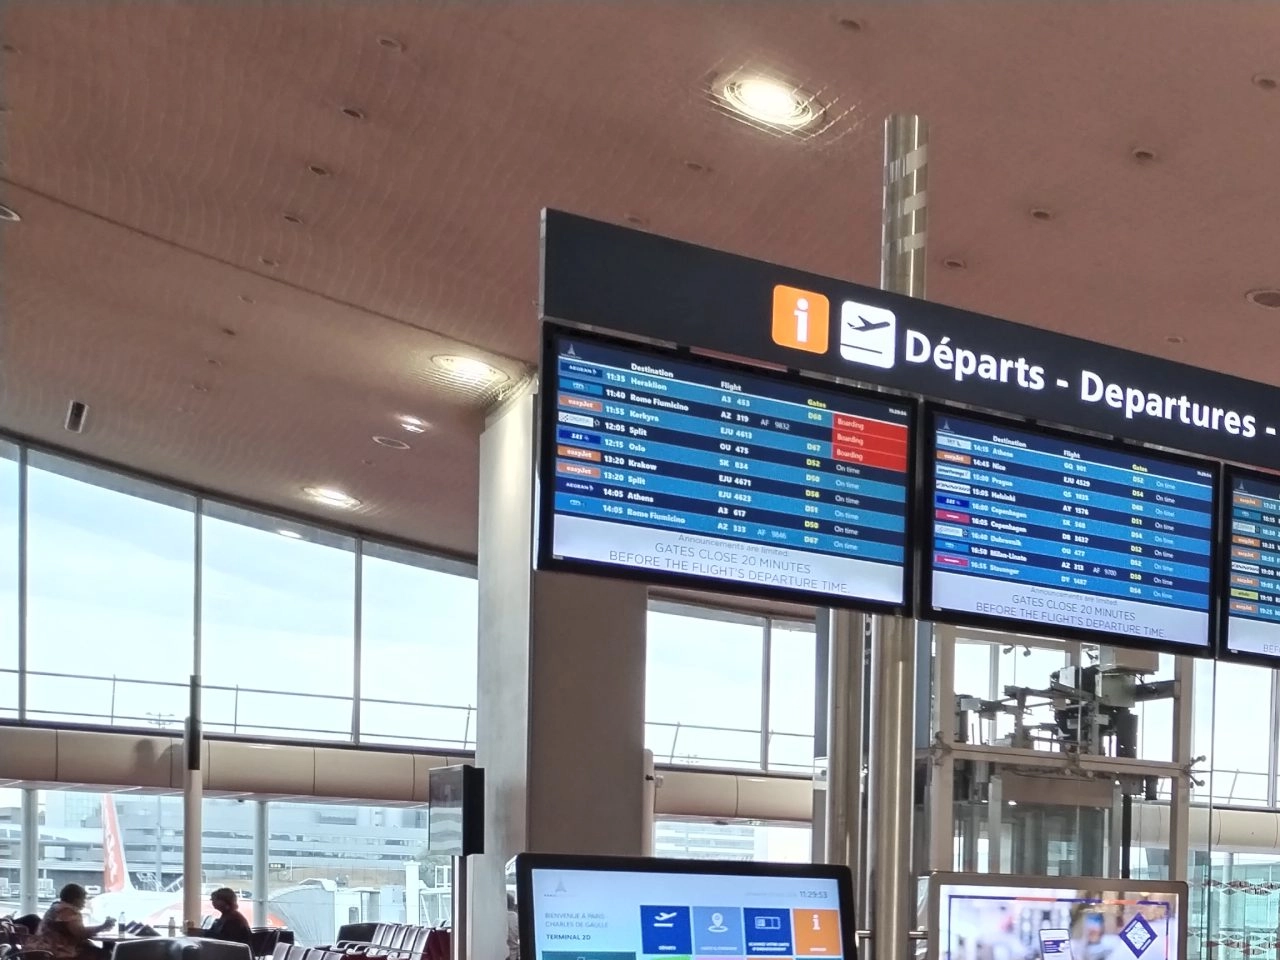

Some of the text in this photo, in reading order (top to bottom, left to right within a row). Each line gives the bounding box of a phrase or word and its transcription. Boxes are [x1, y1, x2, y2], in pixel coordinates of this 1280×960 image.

[606, 372, 626, 383] 11:35
[630, 376, 666, 391] Heraklion
[720, 395, 731, 403] A3
[736, 398, 750, 407] 453
[837, 417, 863, 431] Boarding
[630, 362, 826, 408] Destination Flight Gates
[905, 329, 1045, 390] Départs
[1081, 369, 1256, 438] Departures
[568, 398, 593, 409] easyJet
[605, 405, 625, 416] 11:55
[629, 409, 659, 424] Kerkyra
[719, 427, 733, 436] EJU
[836, 448, 863, 461] Boarding
[606, 389, 626, 399] 11:40
[630, 393, 651, 404] Rome
[652, 397, 688, 411] Fiumicino
[720, 411, 731, 419] AZ
[736, 414, 749, 423] 319
[837, 433, 863, 446] Boarding
[604, 438, 624, 449] 12:15
[628, 442, 645, 452] Oslo
[718, 459, 729, 467] SK
[835, 479, 845, 487] On
[846, 480, 859, 489] time
[605, 422, 625, 432] 12:05
[629, 426, 646, 438] Split
[719, 443, 731, 451] OU
[735, 446, 749, 454] 475
[835, 464, 845, 472] On
[846, 465, 860, 474] time
[992, 434, 1026, 448] Destination
[567, 448, 591, 458] easyJet
[604, 455, 624, 465] 13:20
[628, 458, 656, 471] Krakow
[718, 475, 732, 483] EJU
[835, 494, 844, 502] On
[845, 496, 859, 505] time
[992, 462, 1005, 471] Nice
[566, 465, 591, 475] easyJet
[604, 471, 623, 482] 13:20
[627, 475, 645, 487] Split
[718, 490, 731, 499] EJU
[733, 493, 751, 502] 4623
[845, 511, 858, 520] time
[603, 488, 623, 498] 14:05
[627, 491, 653, 503] Athens
[717, 506, 728, 514] A3
[733, 509, 745, 517] 617
[844, 526, 858, 535] time
[991, 505, 1027, 519] Copenhagen
[603, 504, 622, 514] 14:05
[627, 508, 648, 518] Rome
[649, 511, 685, 524] Fiumicino
[717, 522, 728, 530] AZ
[833, 540, 843, 548] On
[844, 541, 858, 550] time
[678, 533, 744, 550] Announcements
[990, 520, 1026, 534] Copenhagen
[609, 550, 849, 592] BEFORE THE FLIGHT'S DEPARTURE TIME.
[654, 542, 810, 573] GATES CLOSE 20 MINUTES
[976, 601, 1016, 616] BEFORE
[1019, 608, 1038, 619] THE
[1041, 611, 1083, 625] FLIGHT'S
[1086, 617, 1140, 634] DEPARTURE
[1012, 594, 1043, 607] GATES
[1046, 599, 1077, 612] CLOSE
[1080, 604, 1091, 614] 20
[1094, 606, 1135, 621] MINUTES
[799, 890, 828, 899] 11:29:53
